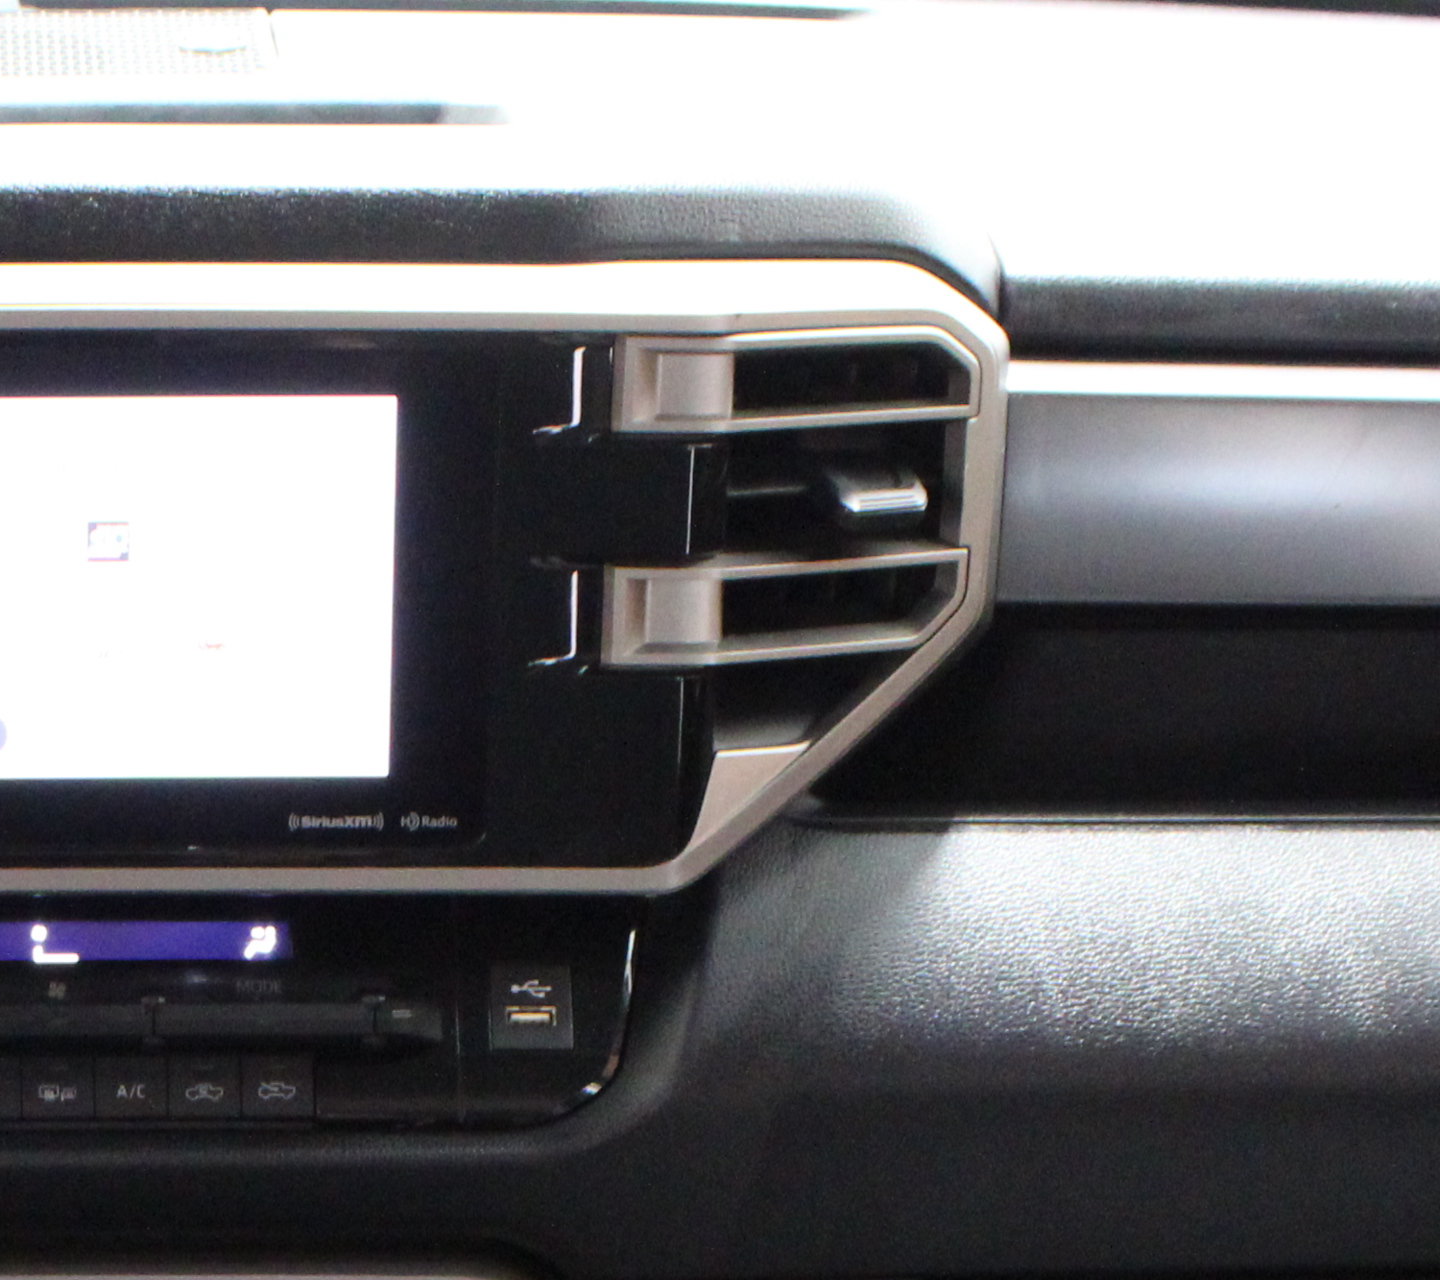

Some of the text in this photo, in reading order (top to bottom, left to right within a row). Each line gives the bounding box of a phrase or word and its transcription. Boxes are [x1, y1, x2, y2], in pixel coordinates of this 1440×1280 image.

[420, 814, 459, 829] Radio
[235, 976, 283, 994] MODE
[115, 1083, 146, 1100] A/C
